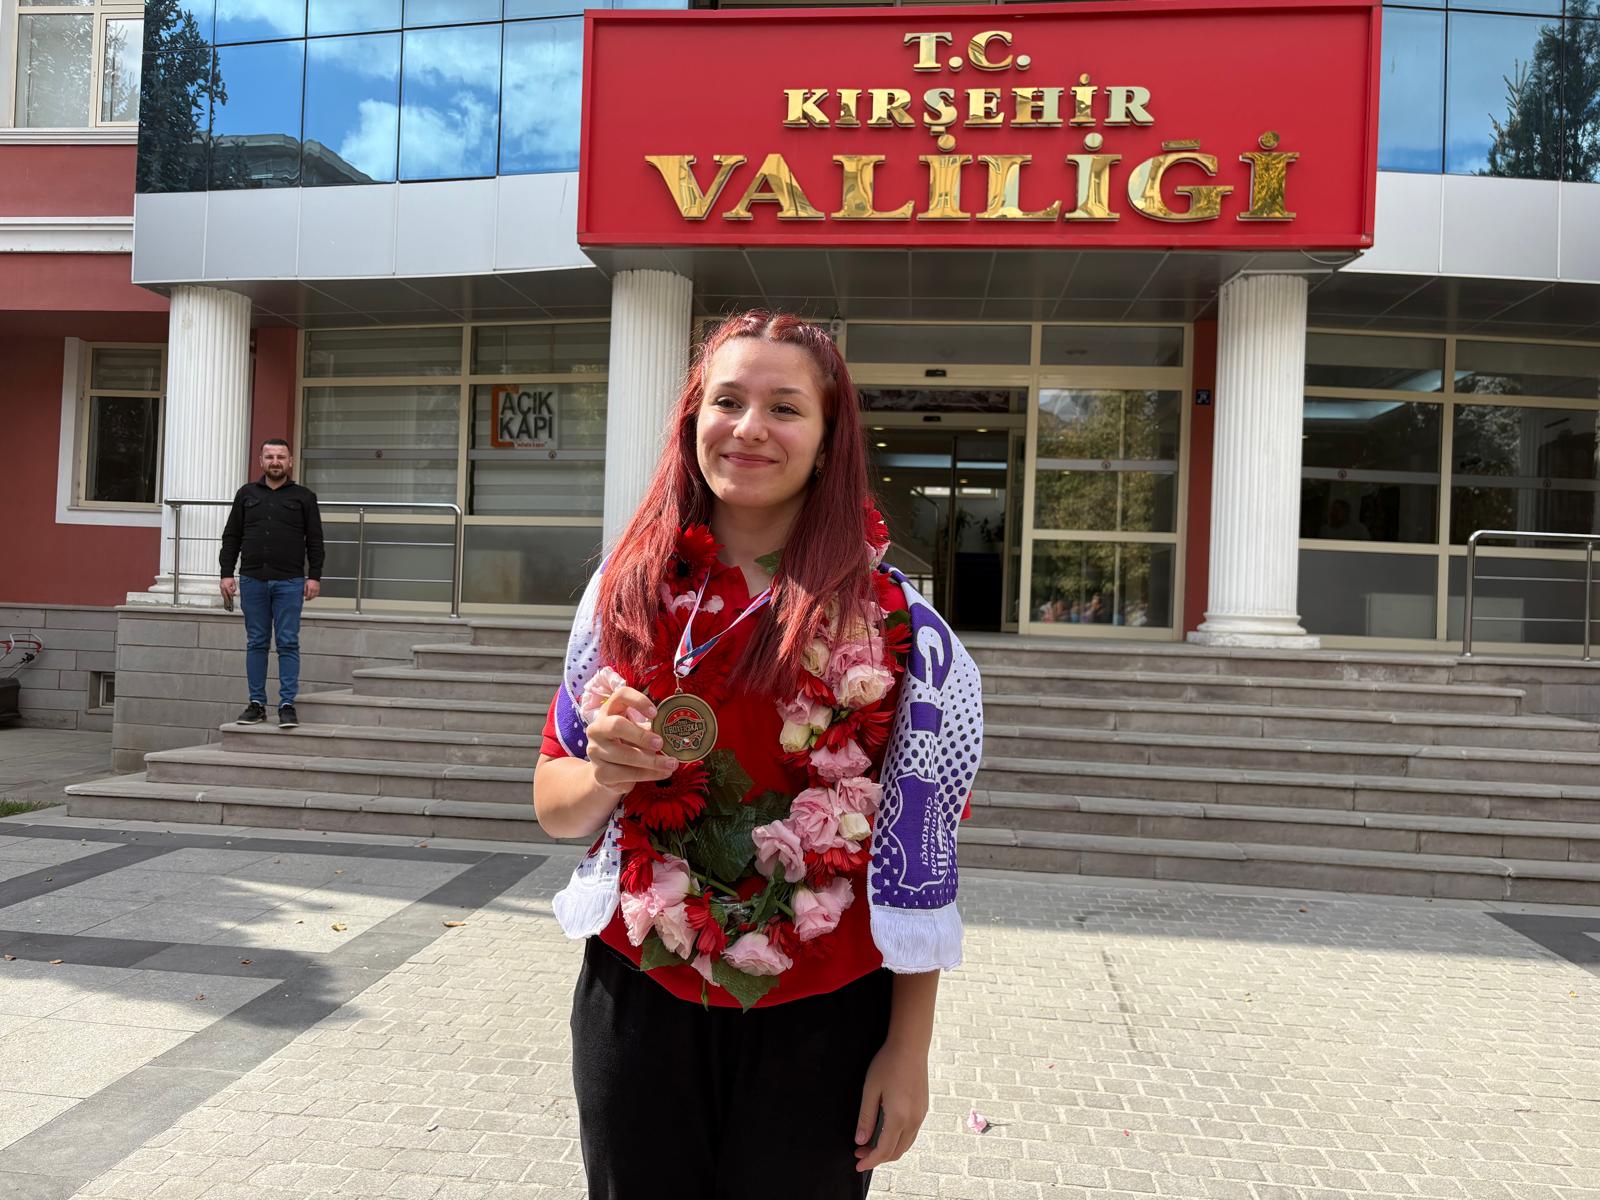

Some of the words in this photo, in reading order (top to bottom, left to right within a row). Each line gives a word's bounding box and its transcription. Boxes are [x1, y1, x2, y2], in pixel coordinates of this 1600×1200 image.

[903, 30, 1032, 72] T.C.
[783, 73, 1154, 136] KIRŞEHİR
[644, 131, 1300, 223] VALİLİĞİ
[499, 414, 553, 439] KAPI
